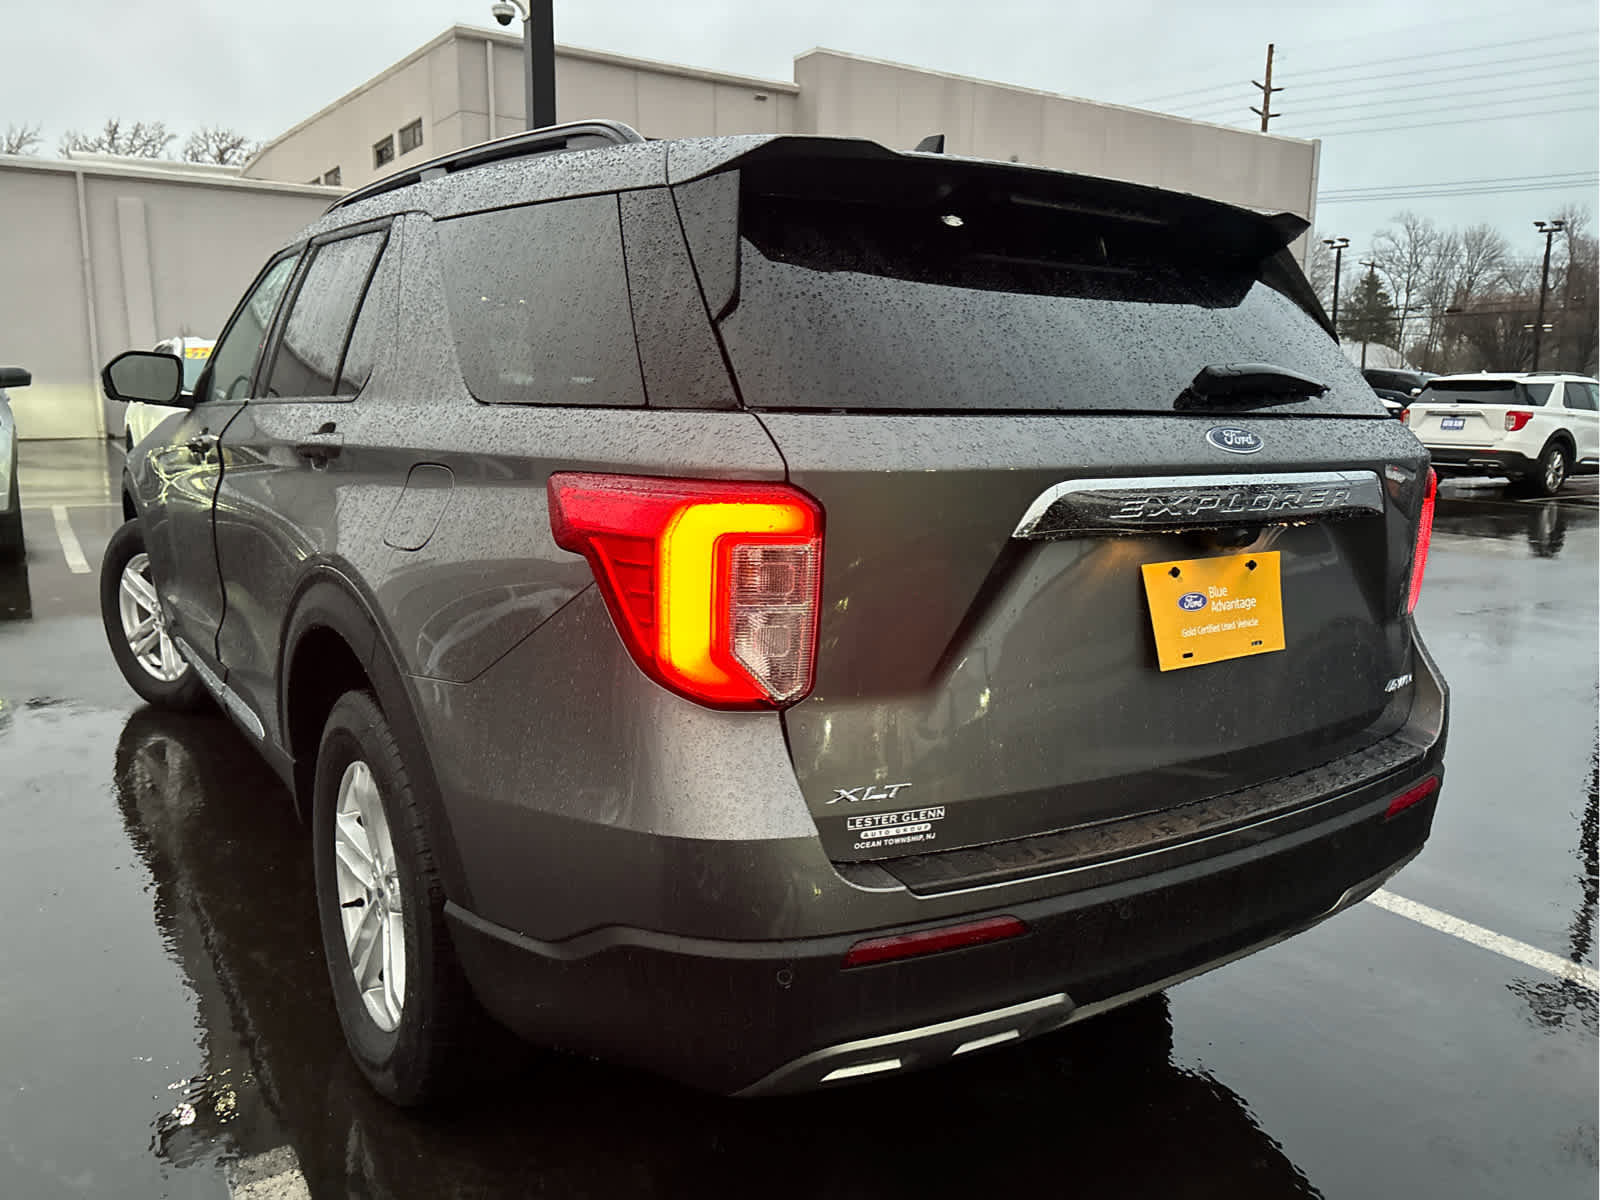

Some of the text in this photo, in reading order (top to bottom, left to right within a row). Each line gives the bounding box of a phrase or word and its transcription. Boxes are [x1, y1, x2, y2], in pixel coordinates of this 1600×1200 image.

[1223, 429, 1255, 445] Ford
[1110, 489, 1351, 518] EXPLORER
[1208, 585, 1228, 598] Blue
[1183, 594, 1204, 609] Ford
[1211, 597, 1257, 612] Advantage
[1181, 617, 1259, 637] Gold Certified Used Vehicle
[825, 782, 912, 804] XLT
[847, 807, 945, 828] LESTER GLENN
[862, 825, 929, 837] AUTO GROUP
[854, 832, 936, 849] OCEAN TOWNSHIP, NJ
